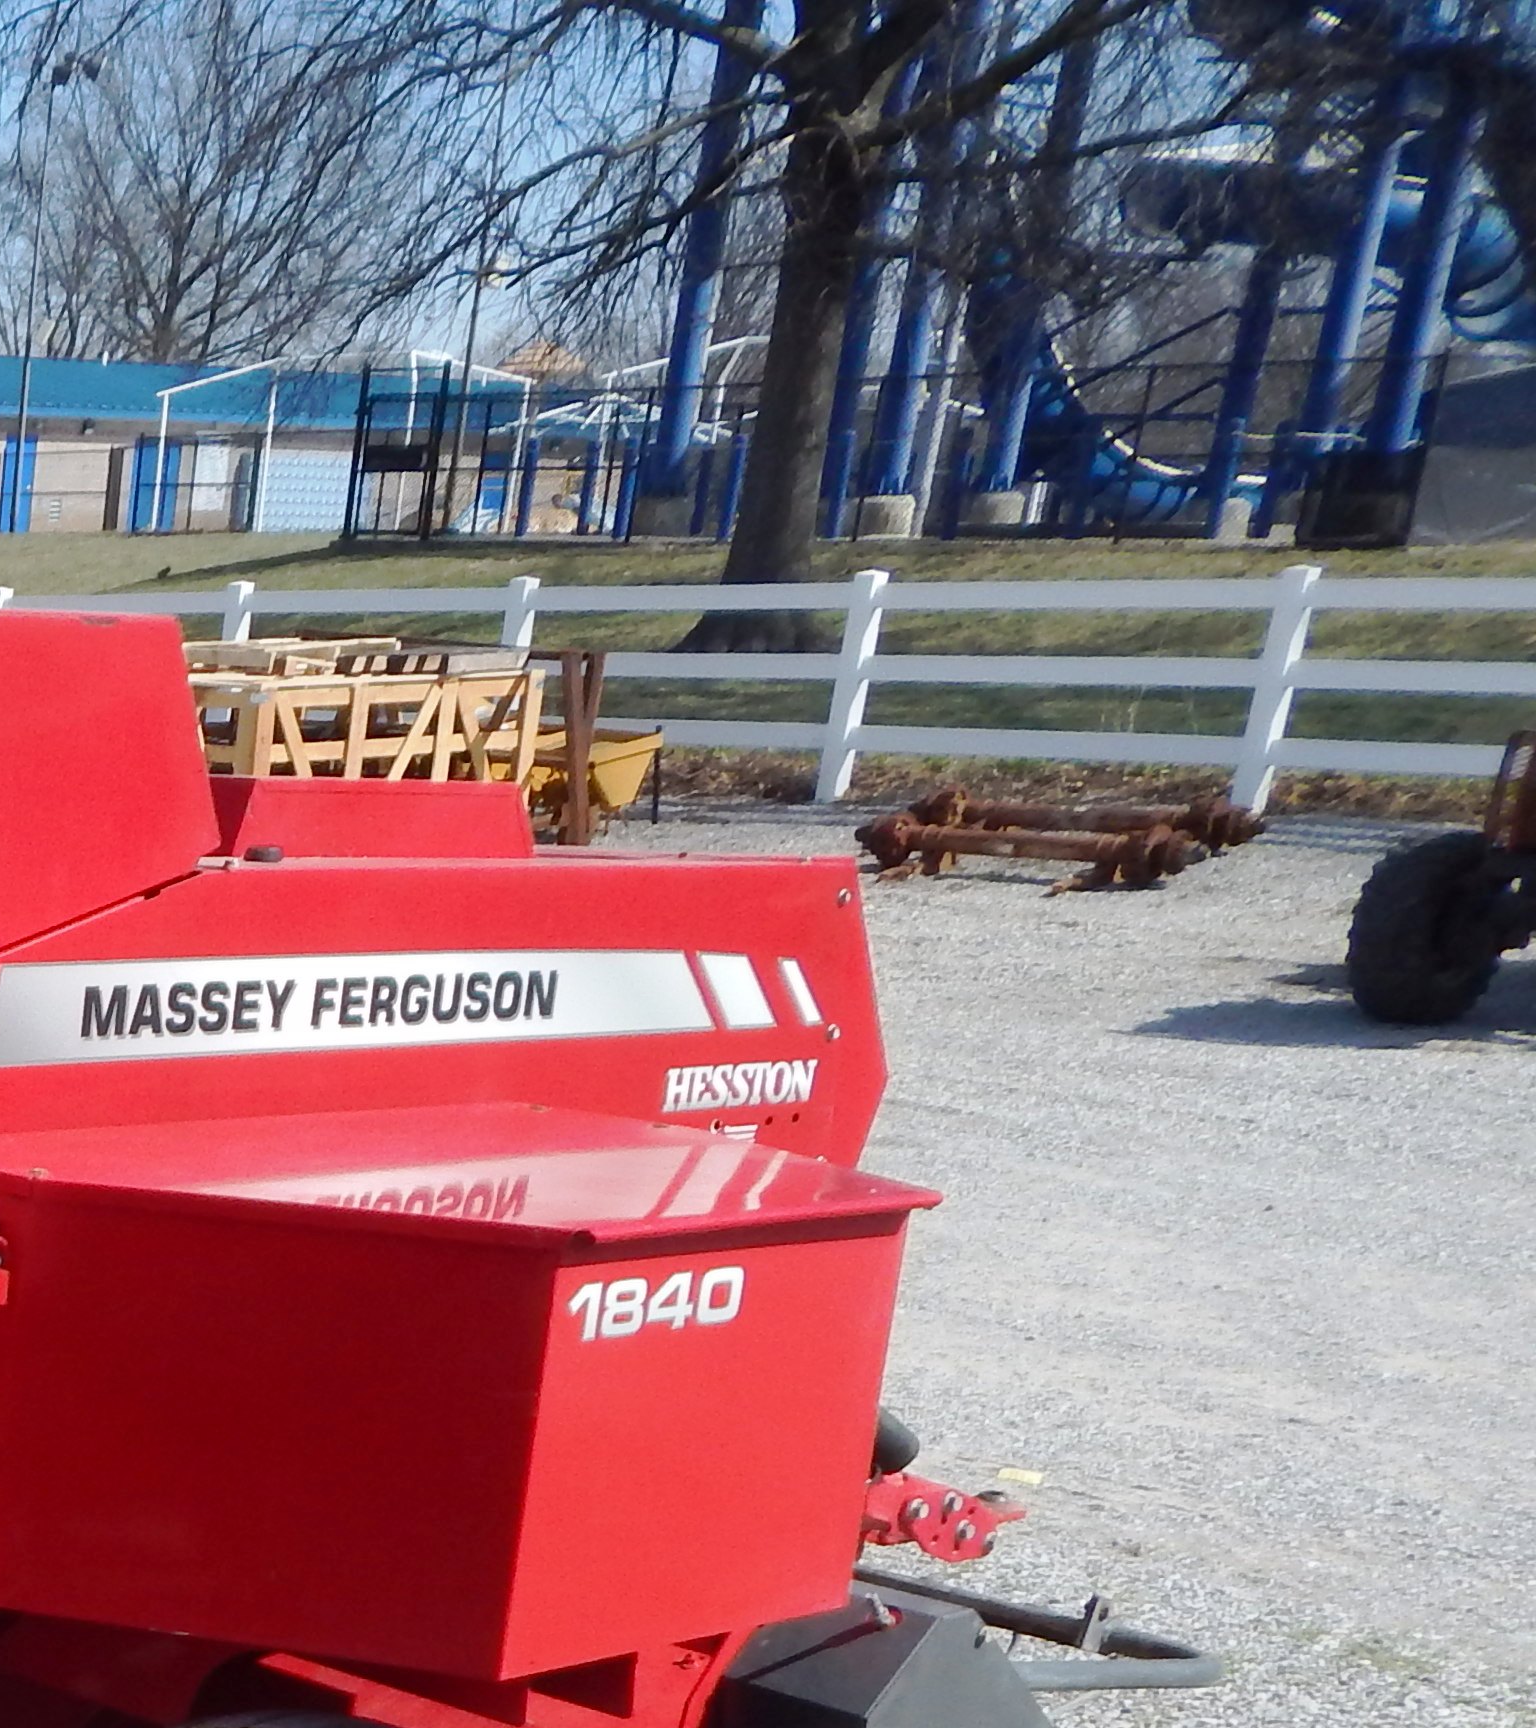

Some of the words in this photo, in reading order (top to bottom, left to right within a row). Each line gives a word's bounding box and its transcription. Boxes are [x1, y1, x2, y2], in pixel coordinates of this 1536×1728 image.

[80, 979, 297, 1039] MASSEY
[310, 969, 559, 1029] FERGUSON
[661, 1058, 819, 1113] HESSTON
[567, 1265, 745, 1342] 1840
